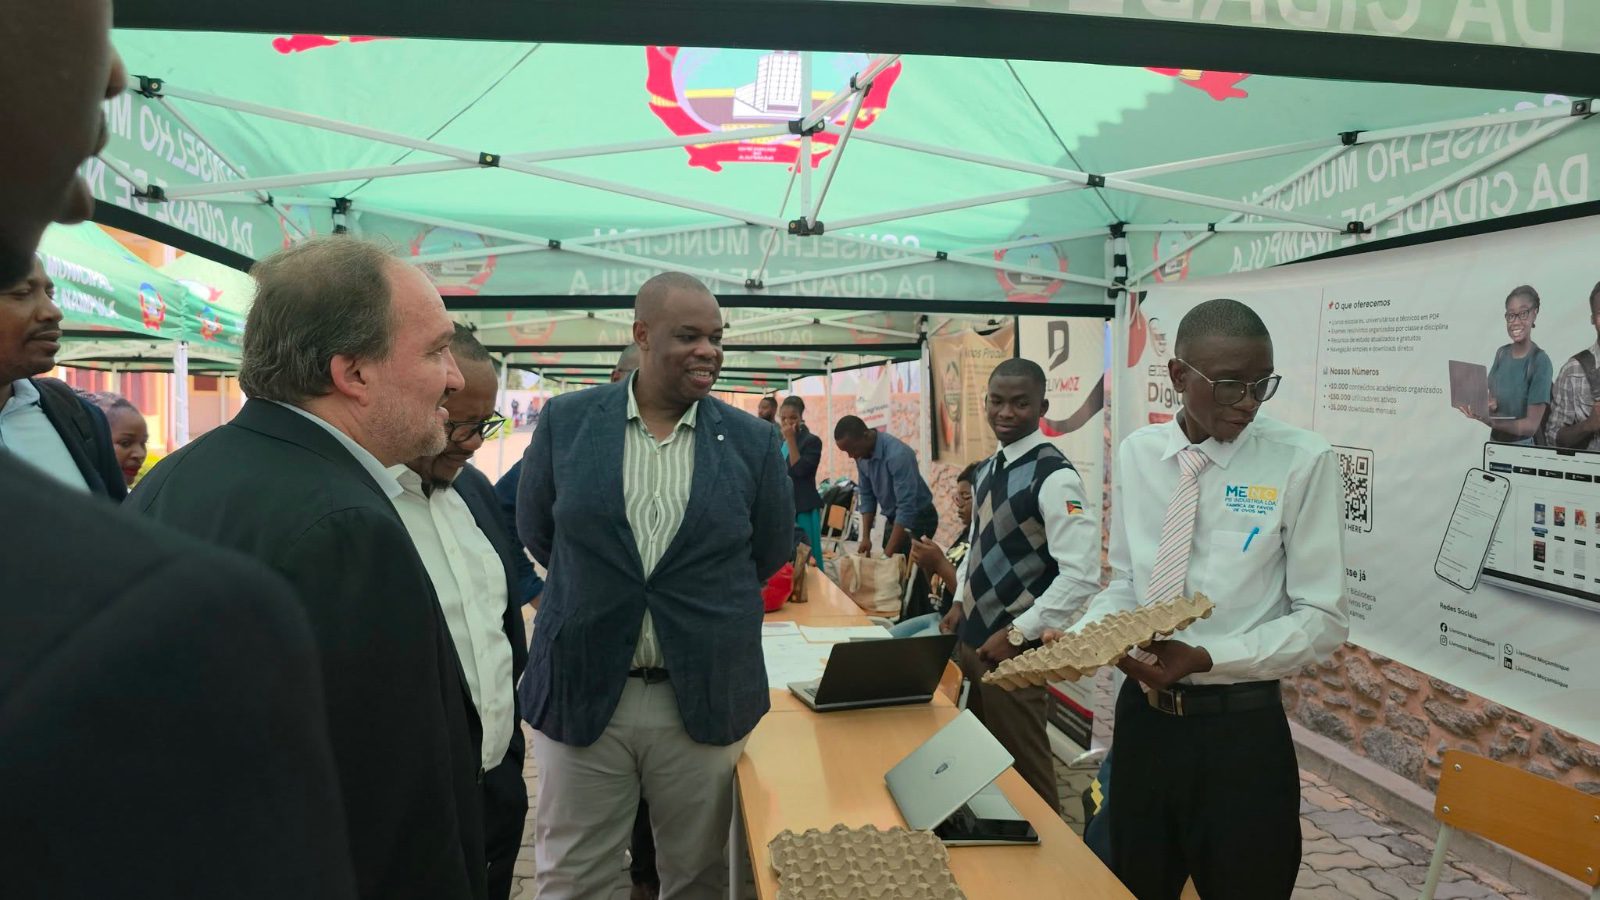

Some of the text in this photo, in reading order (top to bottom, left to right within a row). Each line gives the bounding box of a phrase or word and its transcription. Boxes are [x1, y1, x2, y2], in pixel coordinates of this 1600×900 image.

[1341, 302, 1352, 311] que
[1354, 299, 1391, 309] oferecemos
[1424, 323, 1449, 331] disciplina
[1330, 367, 1379, 376] Nossos Números
[1408, 386, 1443, 394] organizados
[1348, 524, 1361, 533] HERE
[1359, 570, 1366, 582] já
[1440, 602, 1478, 619] Redes Sociais
